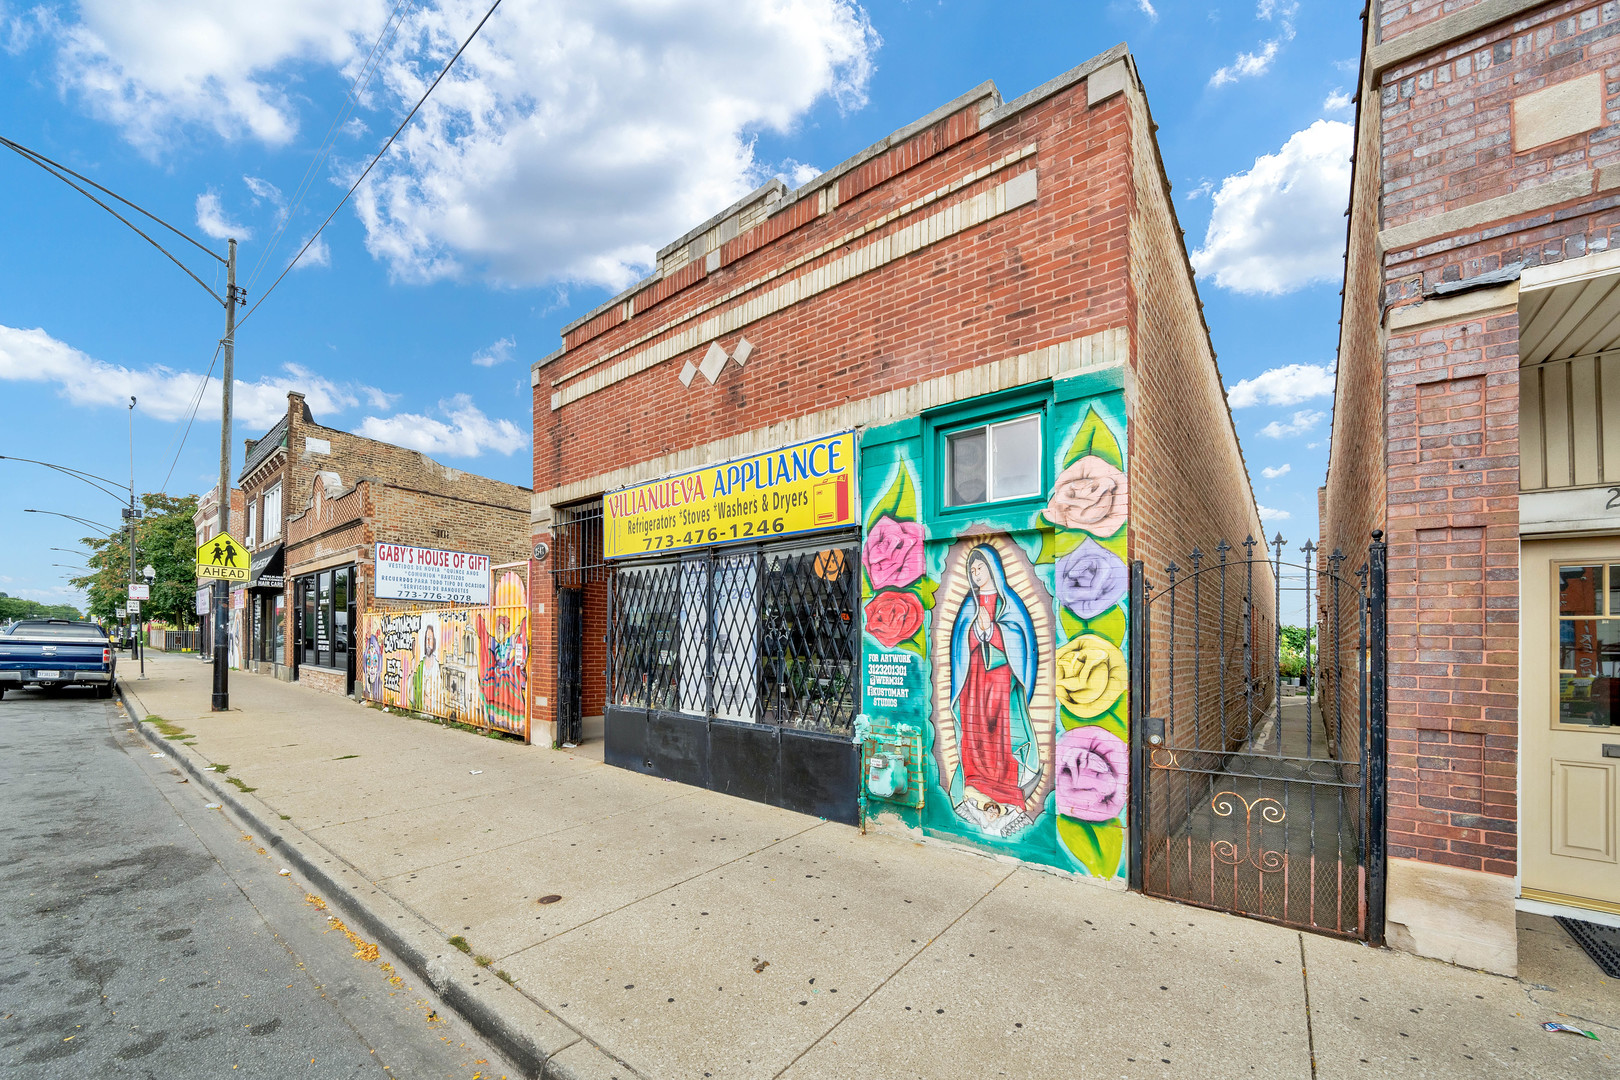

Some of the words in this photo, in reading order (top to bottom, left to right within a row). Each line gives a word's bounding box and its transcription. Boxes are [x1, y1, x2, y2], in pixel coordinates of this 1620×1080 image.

[712, 440, 846, 498] APPLIANCE
[627, 515, 677, 536] Refrigerators
[762, 493, 769, 512] &
[773, 490, 808, 513] Dryers
[642, 517, 785, 551] 773-476-1246
[378, 544, 414, 564] GABY'S
[417, 549, 450, 568] HOUSE
[453, 553, 465, 569] OF
[468, 555, 488, 571] GIFT
[202, 567, 245, 579] AHEAD
[388, 562, 414, 570] VESTIDOS
[424, 565, 440, 573] NOVIA
[381, 575, 413, 583] RECUERDOS
[414, 577, 428, 585] PARA
[444, 580, 456, 588] TIPO
[397, 590, 472, 601] 773-776-2078
[440, 586, 469, 595] BANQUETES
[868, 654, 879, 662] FOR
[880, 654, 911, 663] ARTWORK
[868, 664, 907, 676] 3123201301
[873, 697, 898, 708] STUDIOS
